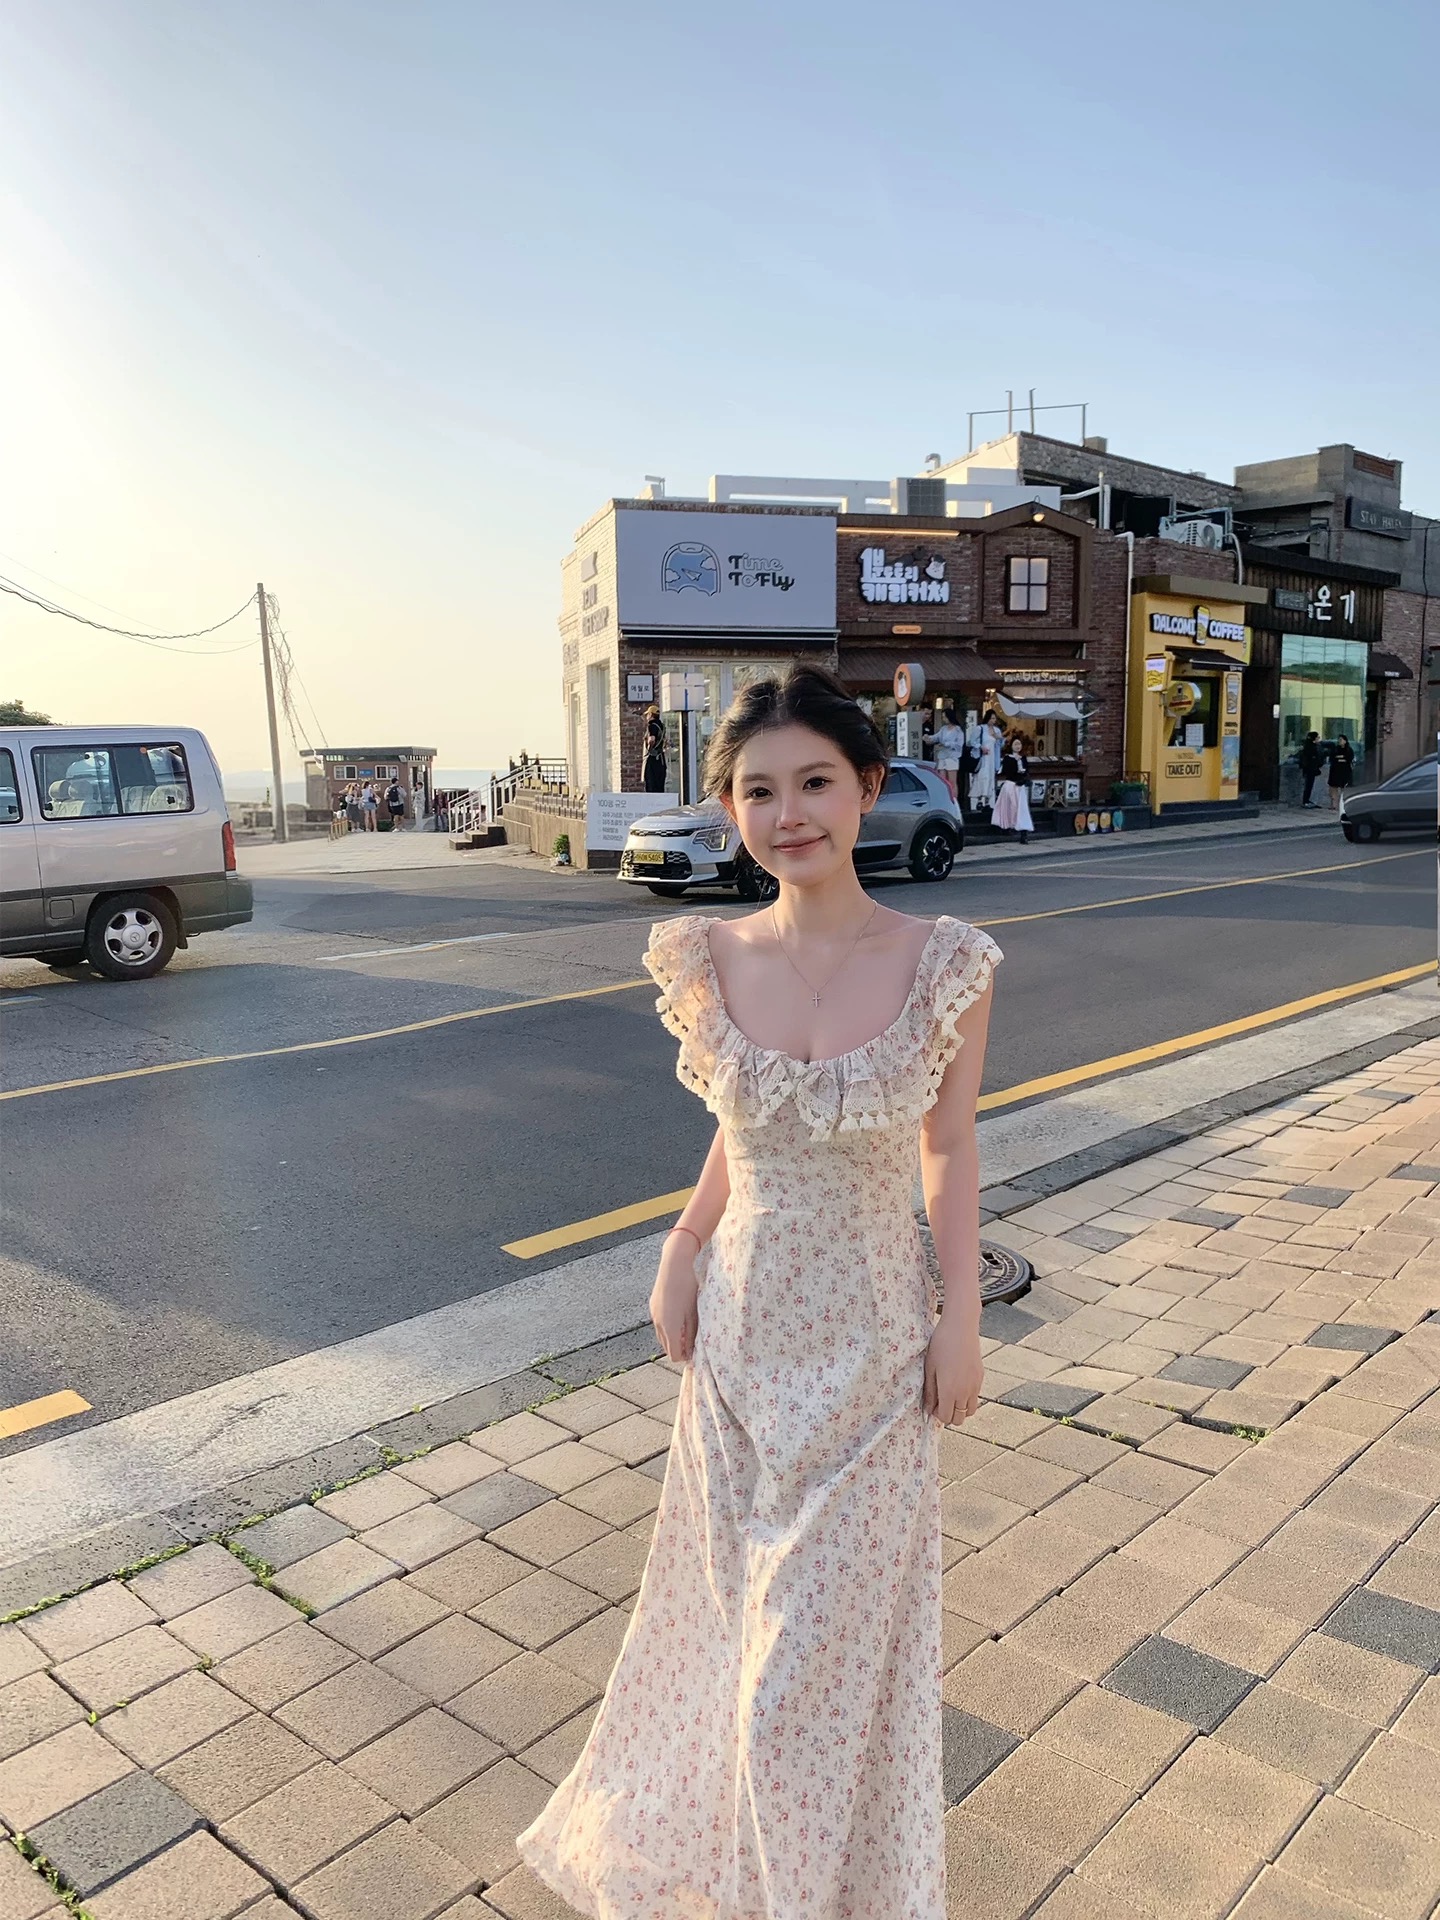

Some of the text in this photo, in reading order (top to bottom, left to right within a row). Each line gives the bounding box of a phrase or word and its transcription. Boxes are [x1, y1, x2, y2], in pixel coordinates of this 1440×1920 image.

[728, 552, 784, 572] Time
[1313, 584, 1356, 624] 온기
[1209, 620, 1245, 641] COFFEE
[1167, 764, 1200, 775] TAKE OUT
